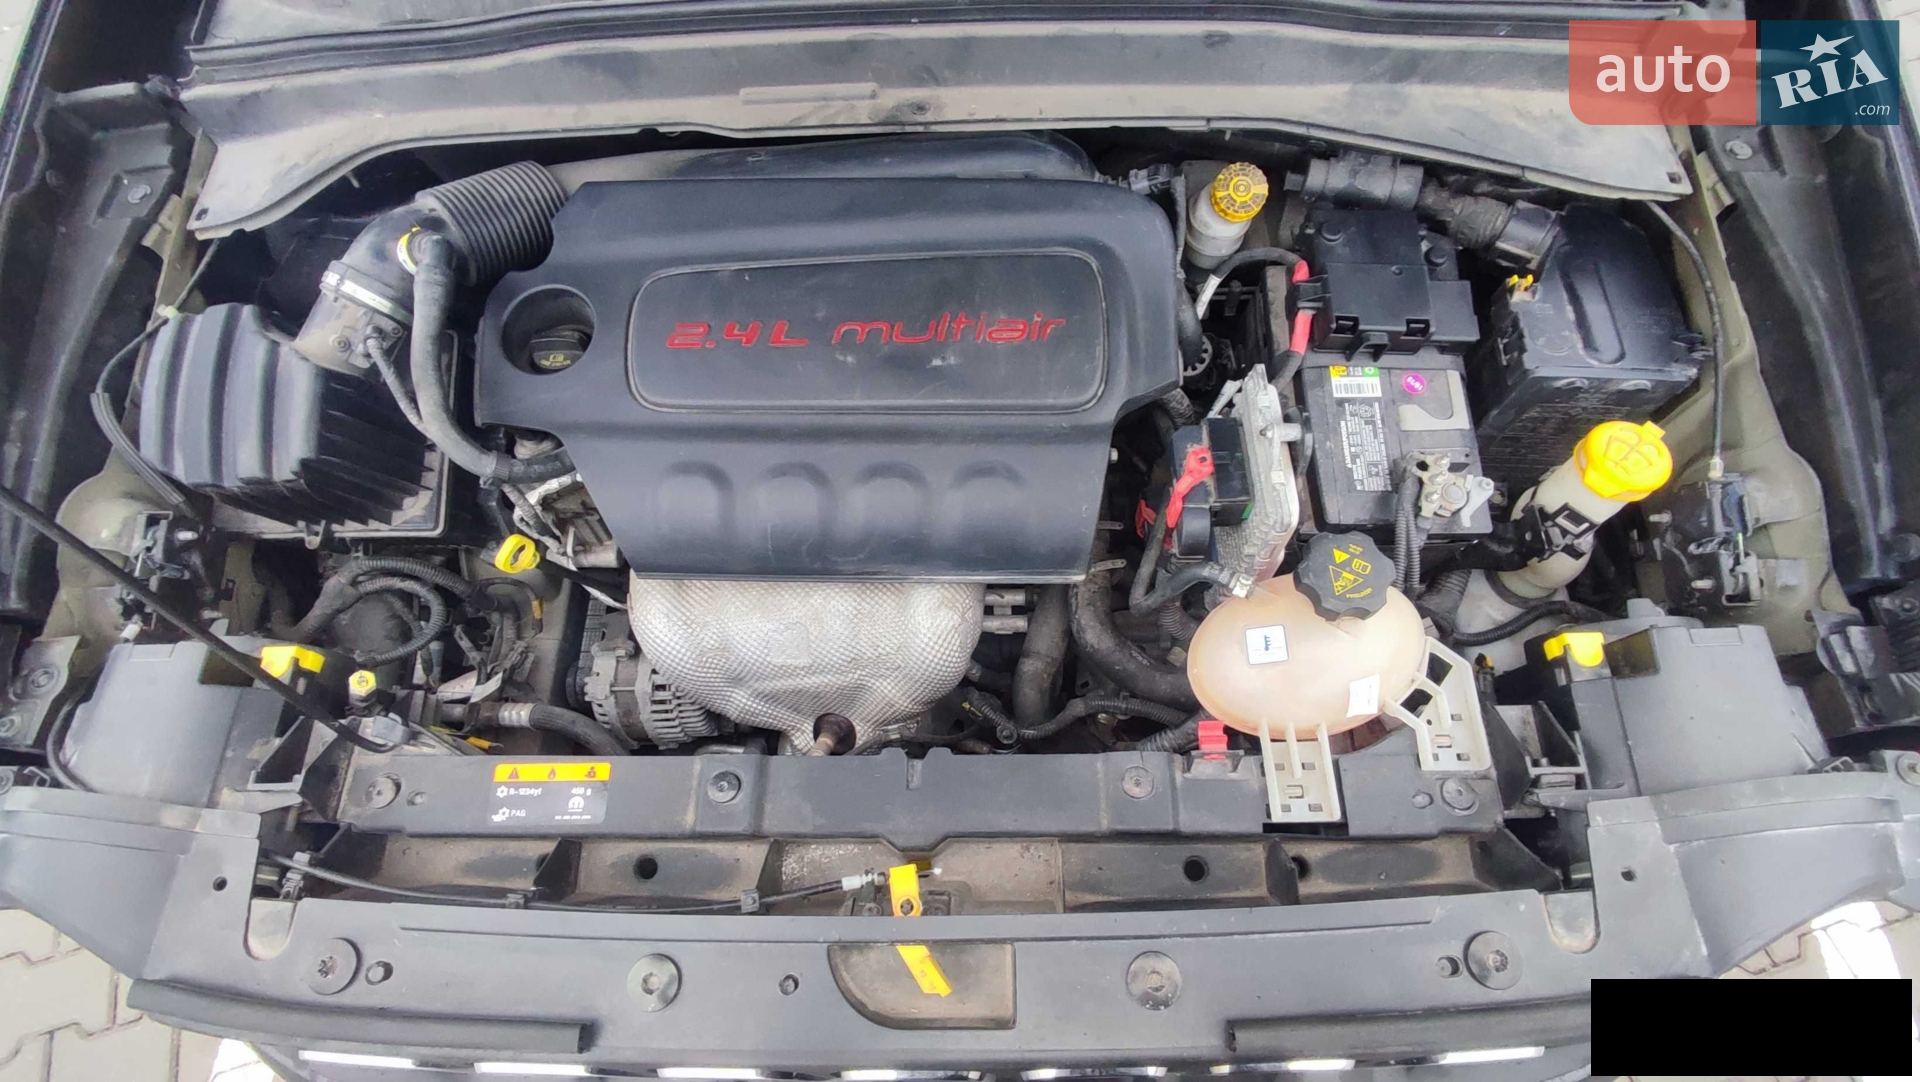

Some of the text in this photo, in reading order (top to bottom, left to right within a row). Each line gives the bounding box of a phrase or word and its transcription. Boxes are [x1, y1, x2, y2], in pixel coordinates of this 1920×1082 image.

[831, 310, 1066, 346] multiair
[509, 787, 543, 797] R-1234yf
[570, 787, 585, 795] 450
[510, 809, 526, 817] PAG
